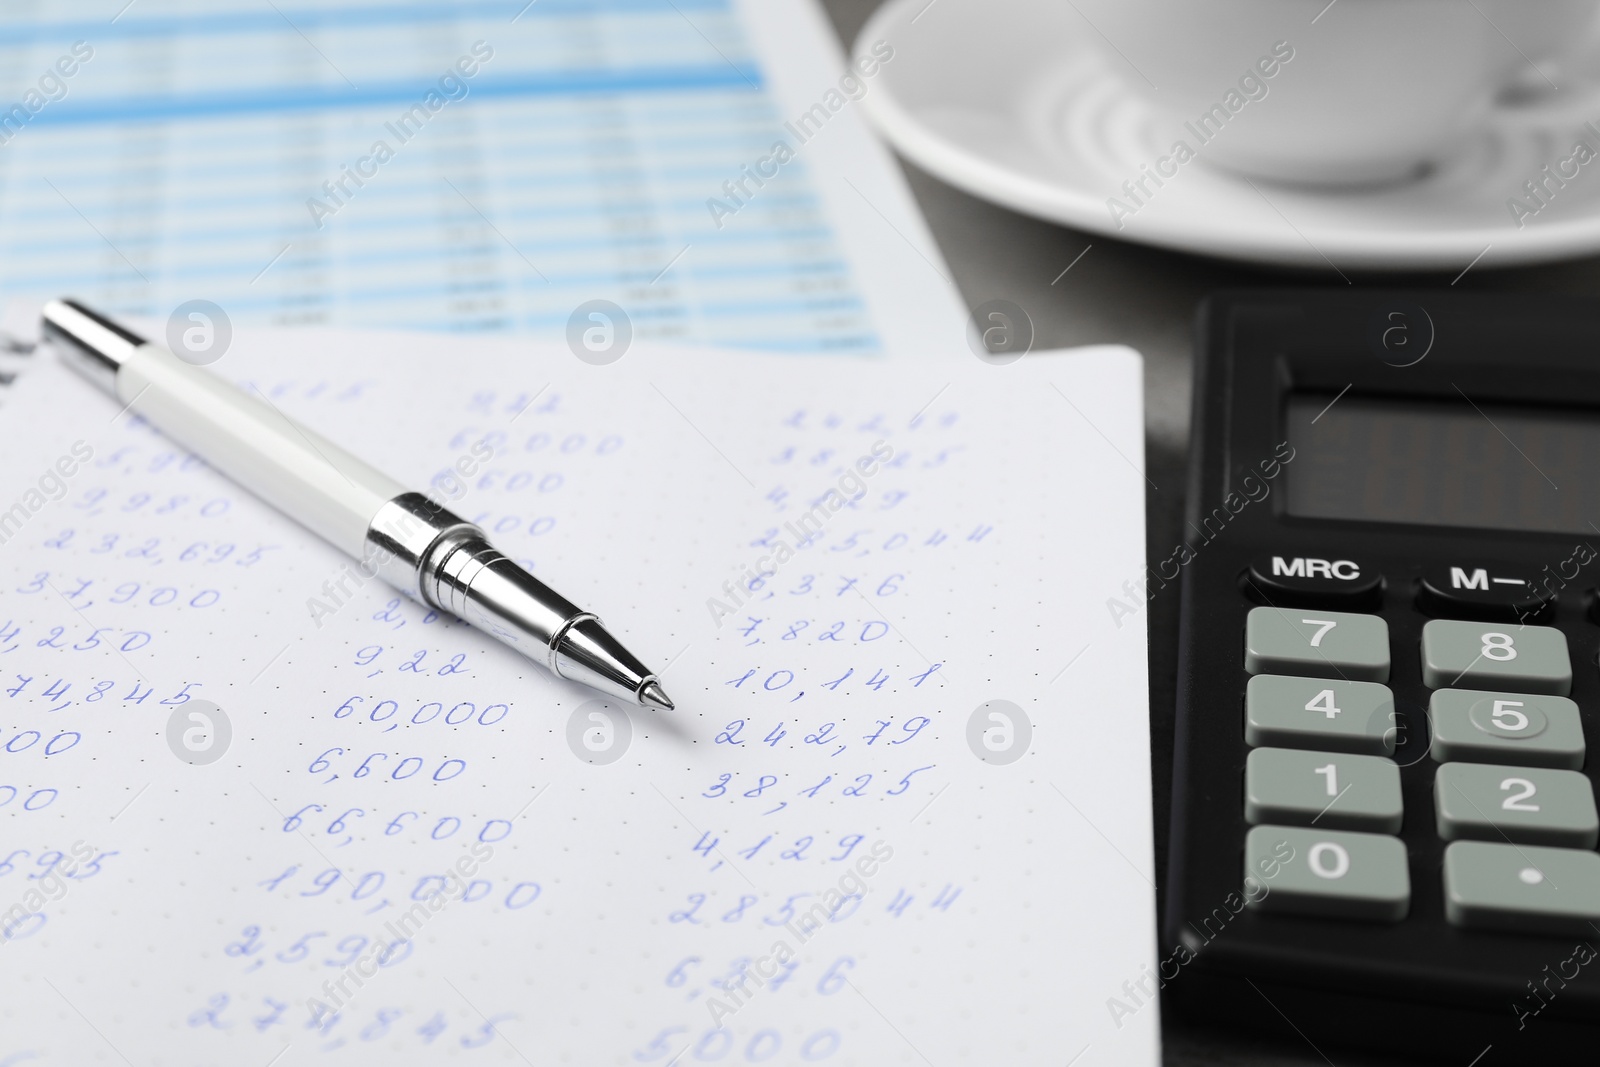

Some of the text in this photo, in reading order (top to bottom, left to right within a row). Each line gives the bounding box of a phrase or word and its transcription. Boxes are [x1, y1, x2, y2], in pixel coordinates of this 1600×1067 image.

[42, 529, 281, 567] 232,695
[747, 570, 906, 601] 6,376
[1271, 556, 1361, 580] MRC
[16, 571, 222, 611] 37,900
[739, 616, 890, 646] 7,820
[1301, 619, 1337, 647] 7
[1481, 632, 1518, 661] 8
[354, 645, 468, 679] 9,22
[725, 663, 943, 702] 10,141
[333, 695, 510, 733] 60,000
[1304, 689, 1341, 719] 4
[1491, 700, 1529, 731] 5
[713, 715, 932, 757] 242,79
[308, 747, 468, 784] 6,600
[1314, 764, 1338, 796] 1
[701, 765, 934, 815] 38,125
[1500, 778, 1540, 812] 2
[282, 803, 513, 847] 66,600
[691, 830, 866, 873] 4,129
[1307, 841, 1350, 880] 0
[257, 865, 543, 914] 190,000
[666, 883, 964, 935] 285,044
[223, 924, 415, 973] 2,590
[664, 955, 857, 1002] 6,376
[186, 992, 514, 1053] 274,845
